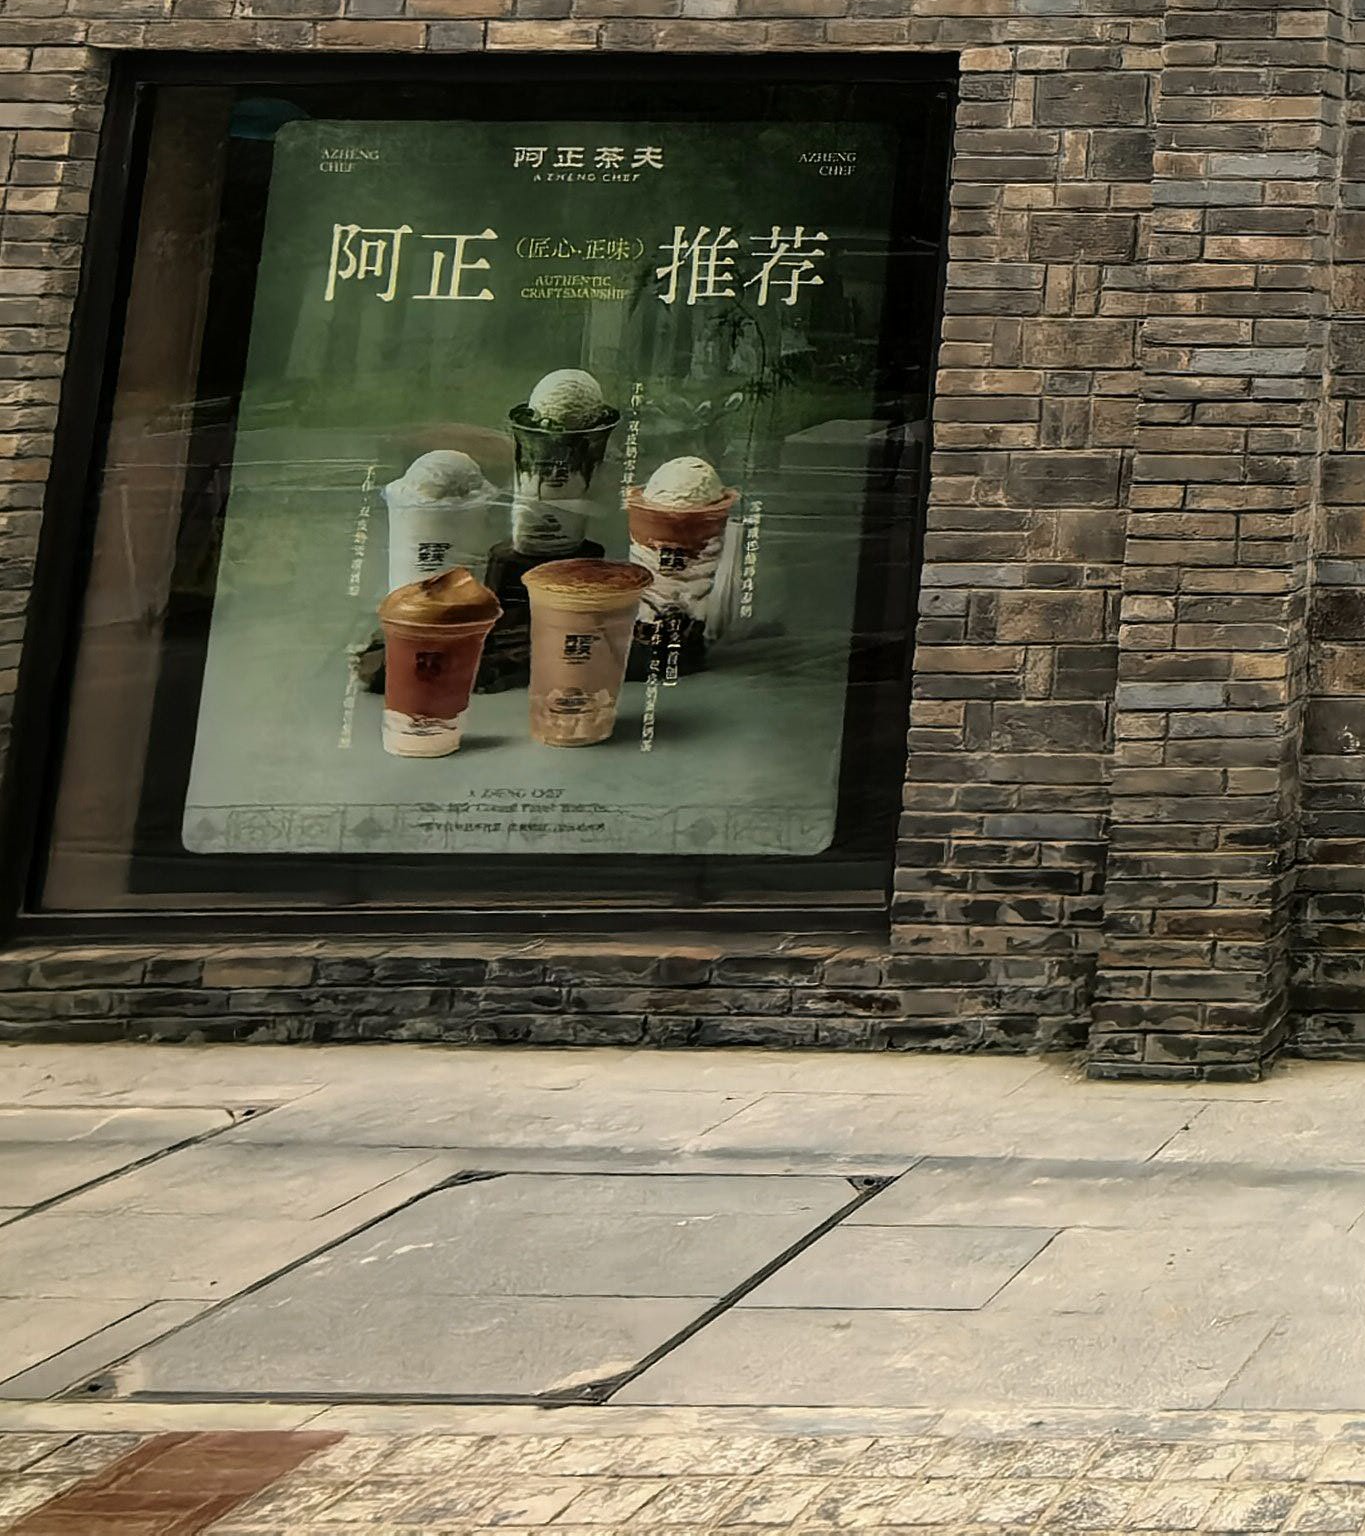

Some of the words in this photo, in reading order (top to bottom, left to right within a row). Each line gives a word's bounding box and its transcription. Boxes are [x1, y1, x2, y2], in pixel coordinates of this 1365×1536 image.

[512, 146, 664, 168] 阿正茶夫
[818, 164, 857, 176] CHEF
[602, 173, 641, 183] CHEF
[324, 223, 498, 302] 阿正
[656, 226, 829, 306] 推荐
[534, 274, 612, 287] AUTHENTIC
[520, 287, 630, 300] CRAFTSMANSHIP
